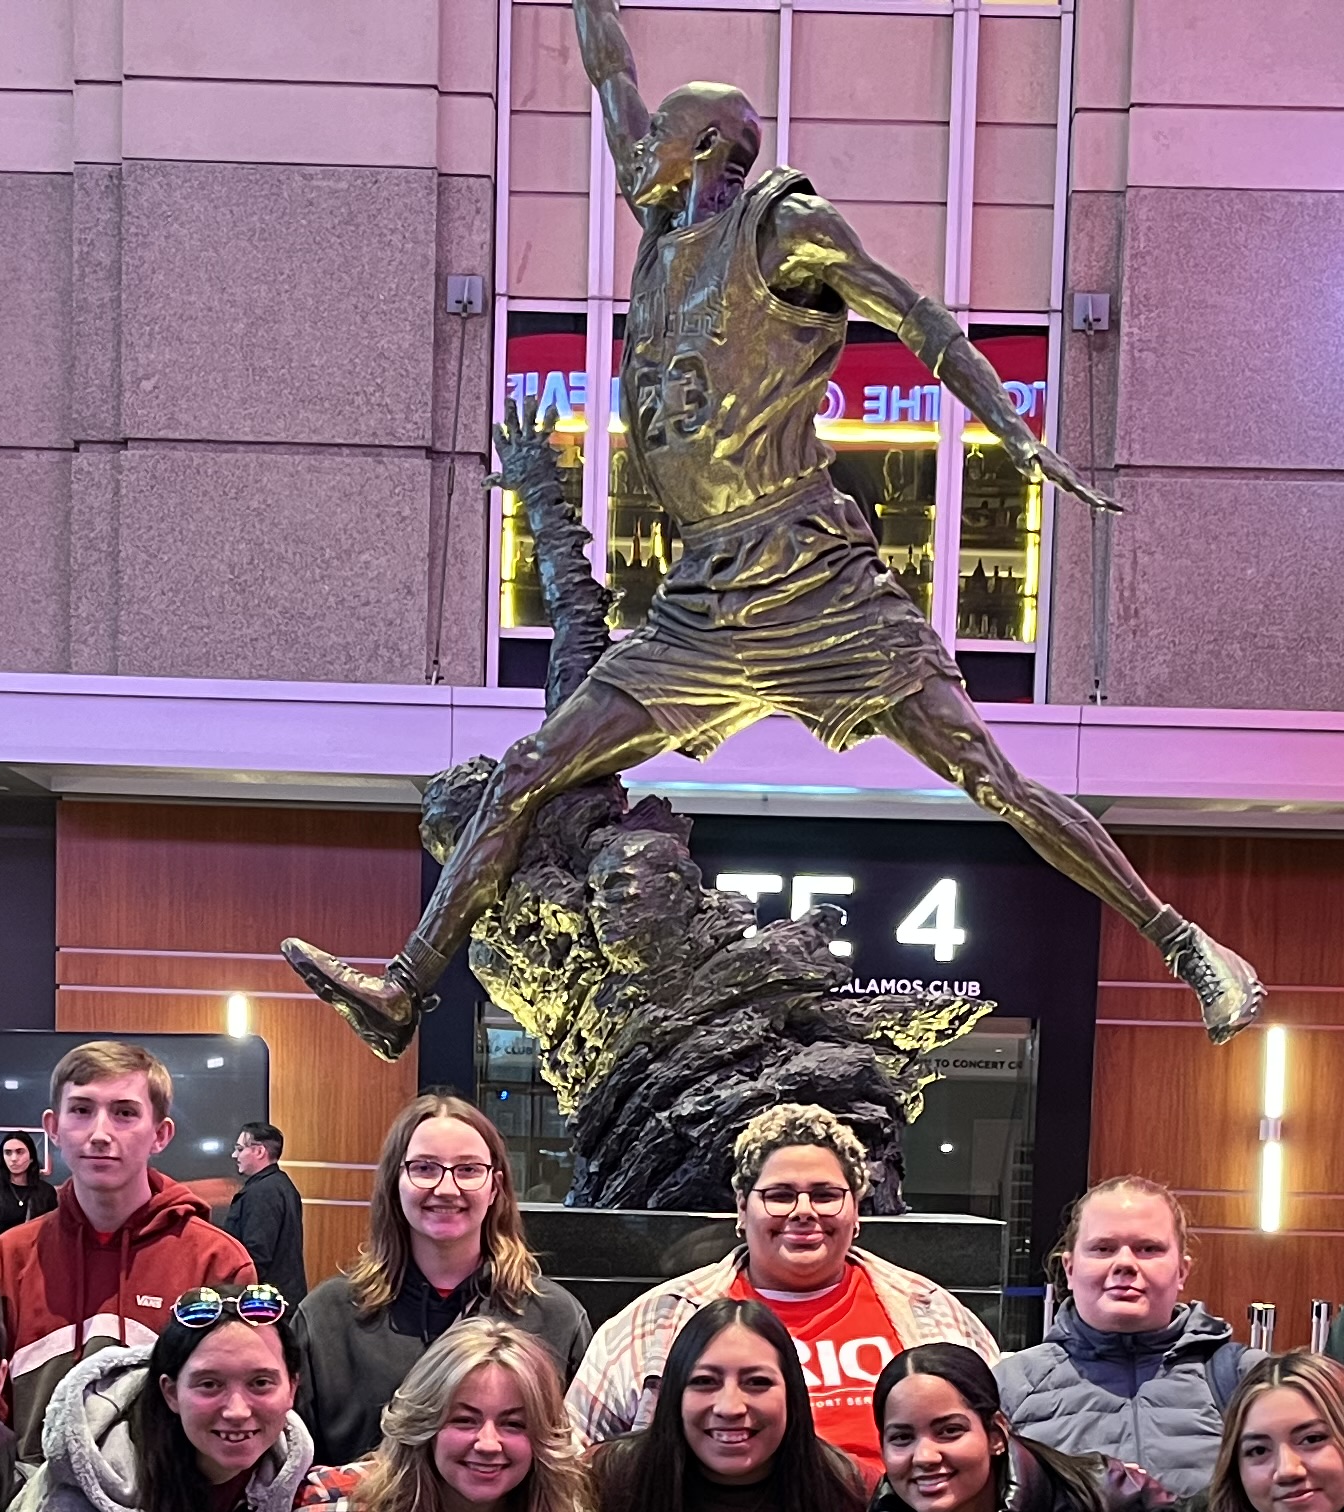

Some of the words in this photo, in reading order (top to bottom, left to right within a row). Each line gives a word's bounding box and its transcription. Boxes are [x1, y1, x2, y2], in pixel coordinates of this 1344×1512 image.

[896, 878, 965, 962] 4
[830, 978, 923, 994] ALAMOS
[929, 980, 981, 997] CLUB
[936, 1059, 950, 1069] TO
[952, 1059, 1005, 1070] CONCERT
[790, 1335, 895, 1388] RIO
